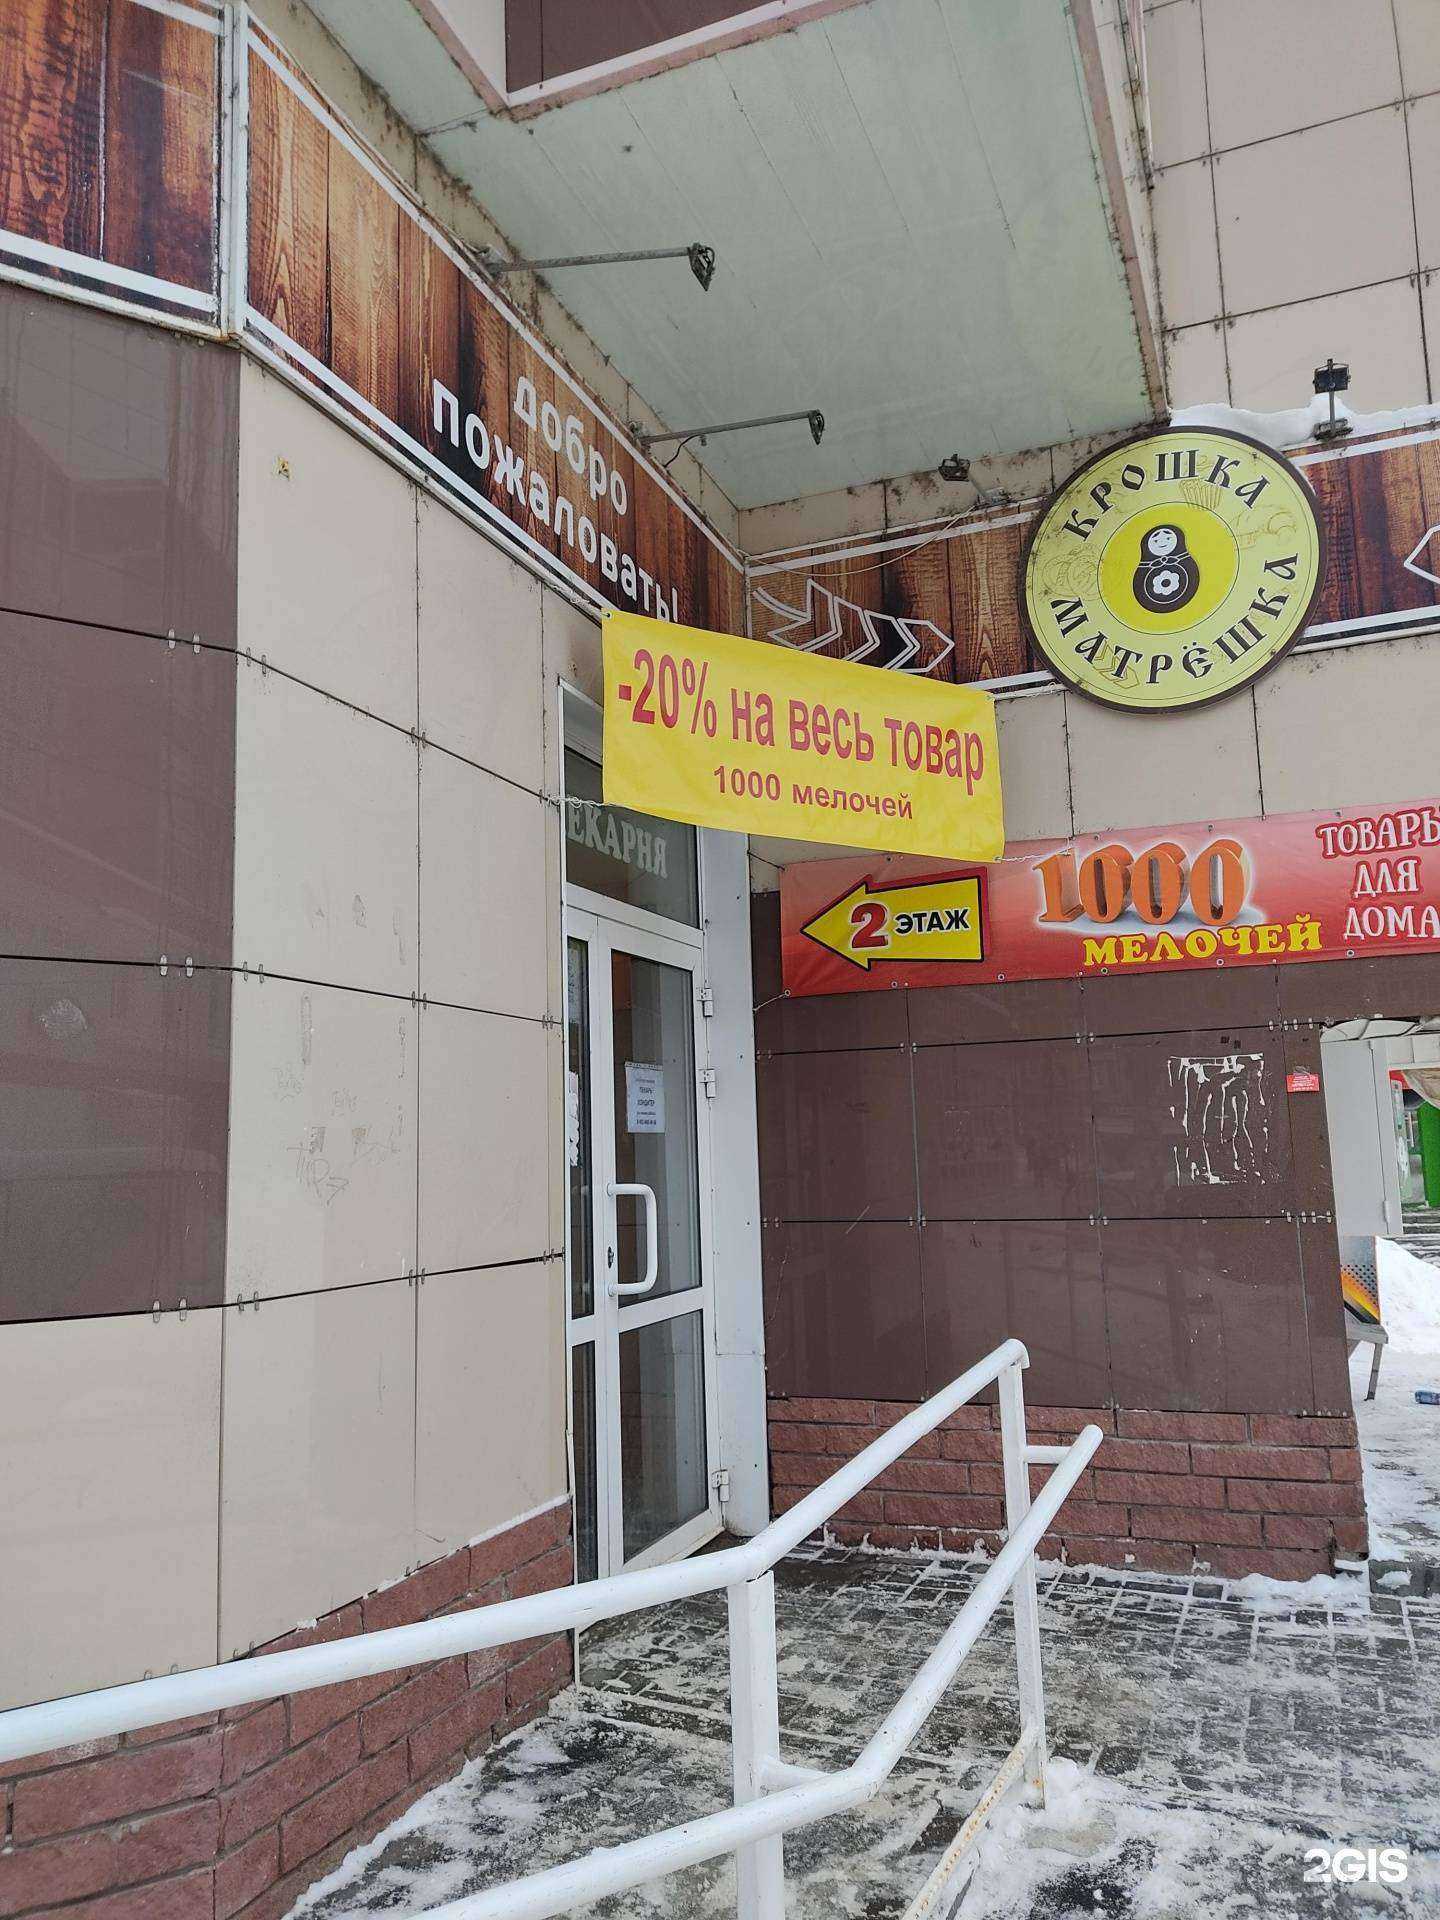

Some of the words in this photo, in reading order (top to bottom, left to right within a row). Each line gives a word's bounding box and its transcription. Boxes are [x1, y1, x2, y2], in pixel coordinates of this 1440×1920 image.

[514, 376, 628, 516] добро
[1063, 449, 1271, 542] КРОШКА
[1050, 553, 1299, 684] МАТРЁШКА
[617, 648, 717, 738] -20%
[730, 687, 775, 747] на
[789, 699, 875, 763] весь
[884, 716, 984, 795] товар
[714, 764, 782, 801] 1000
[792, 779, 913, 820] мелочей
[568, 804, 668, 879] ЕКАРНЯ
[1354, 859, 1420, 898] ДЛЯ
[1033, 838, 1247, 927] 1000
[851, 902, 890, 949] 2
[895, 907, 971, 935] ЭТАЖ
[1082, 913, 1323, 967] МЕЛОЧЕЙ
[1343, 905, 1440, 941] ДОМА
